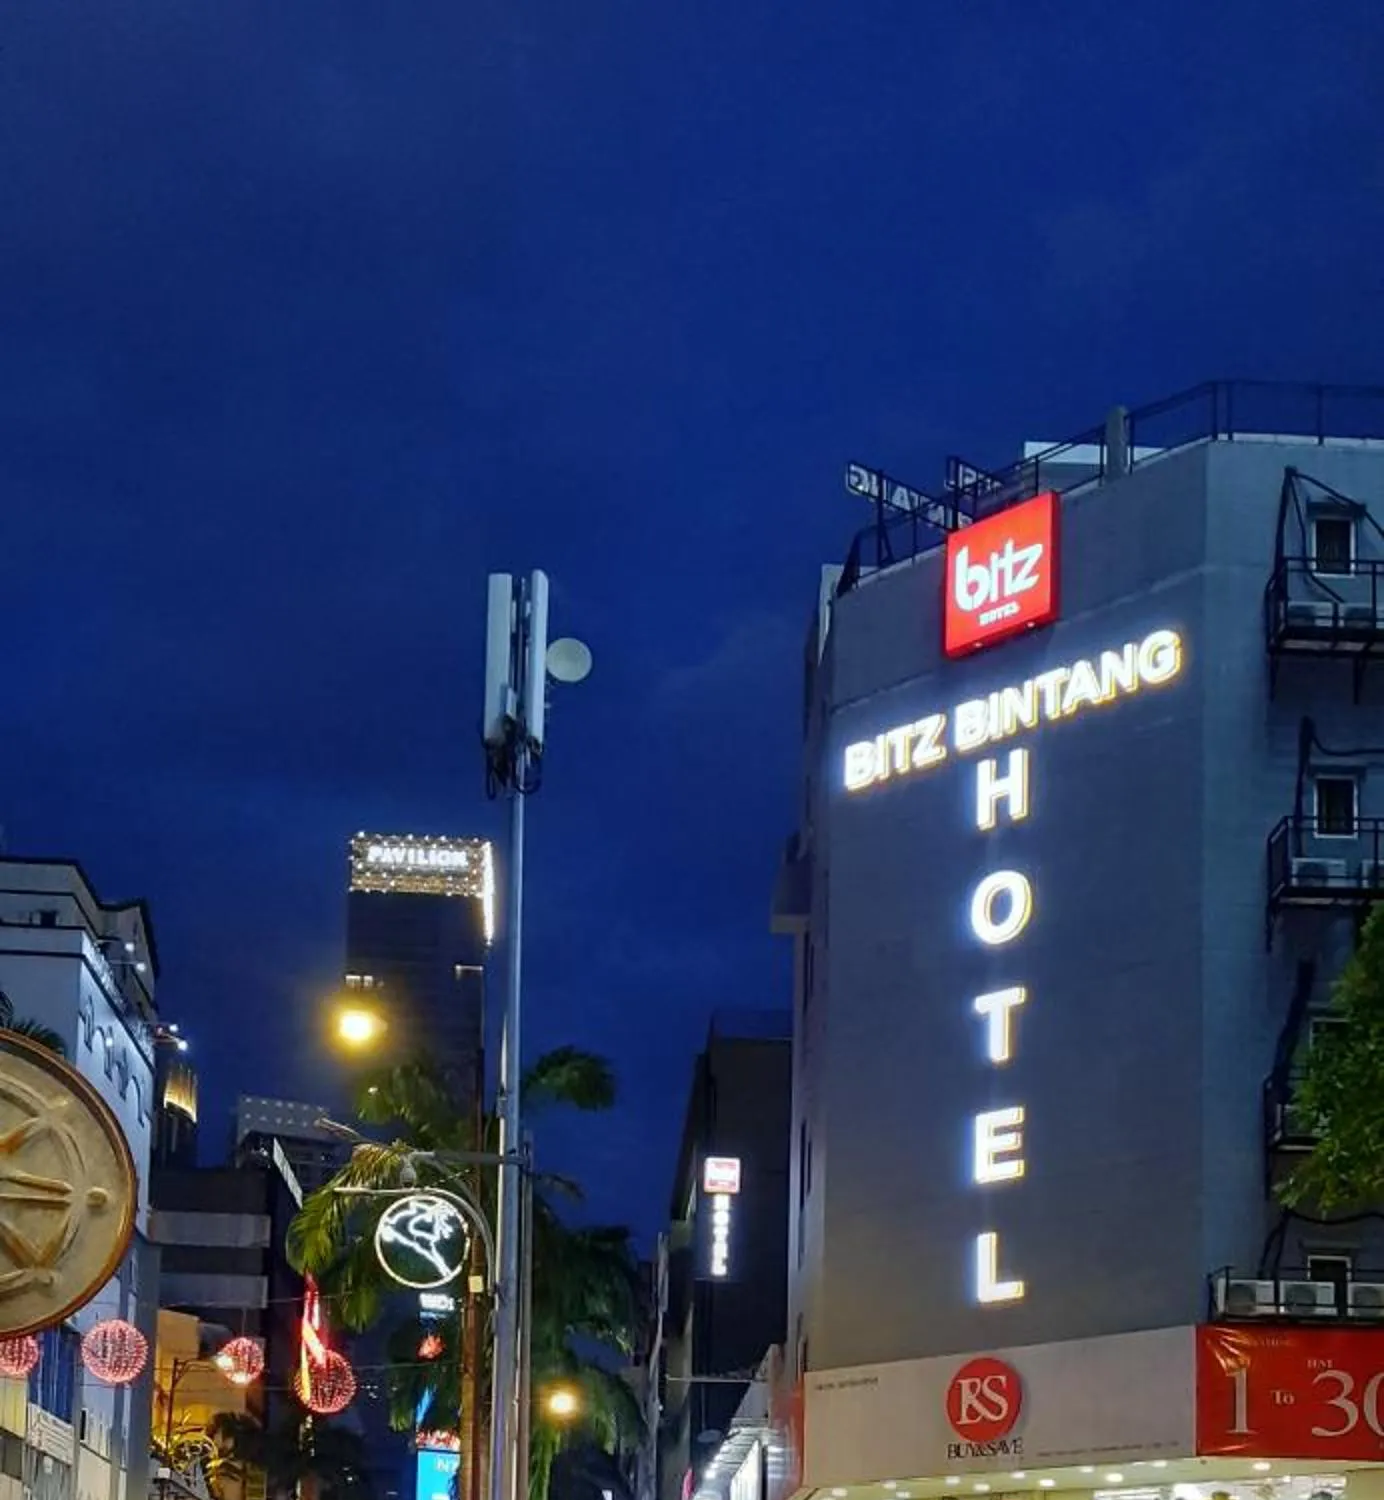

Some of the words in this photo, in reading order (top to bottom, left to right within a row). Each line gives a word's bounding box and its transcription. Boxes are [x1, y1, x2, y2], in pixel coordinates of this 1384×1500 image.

[955, 537, 1043, 611] bitz
[843, 712, 947, 792] BITZ
[953, 629, 1184, 752] BINTANG
[367, 846, 468, 867] PAVILION
[970, 748, 1032, 1304] HOTEL
[1226, 1368, 1258, 1434] 1
[1271, 1390, 1295, 1405] To
[946, 1437, 1024, 1459] BUY&SAVE
